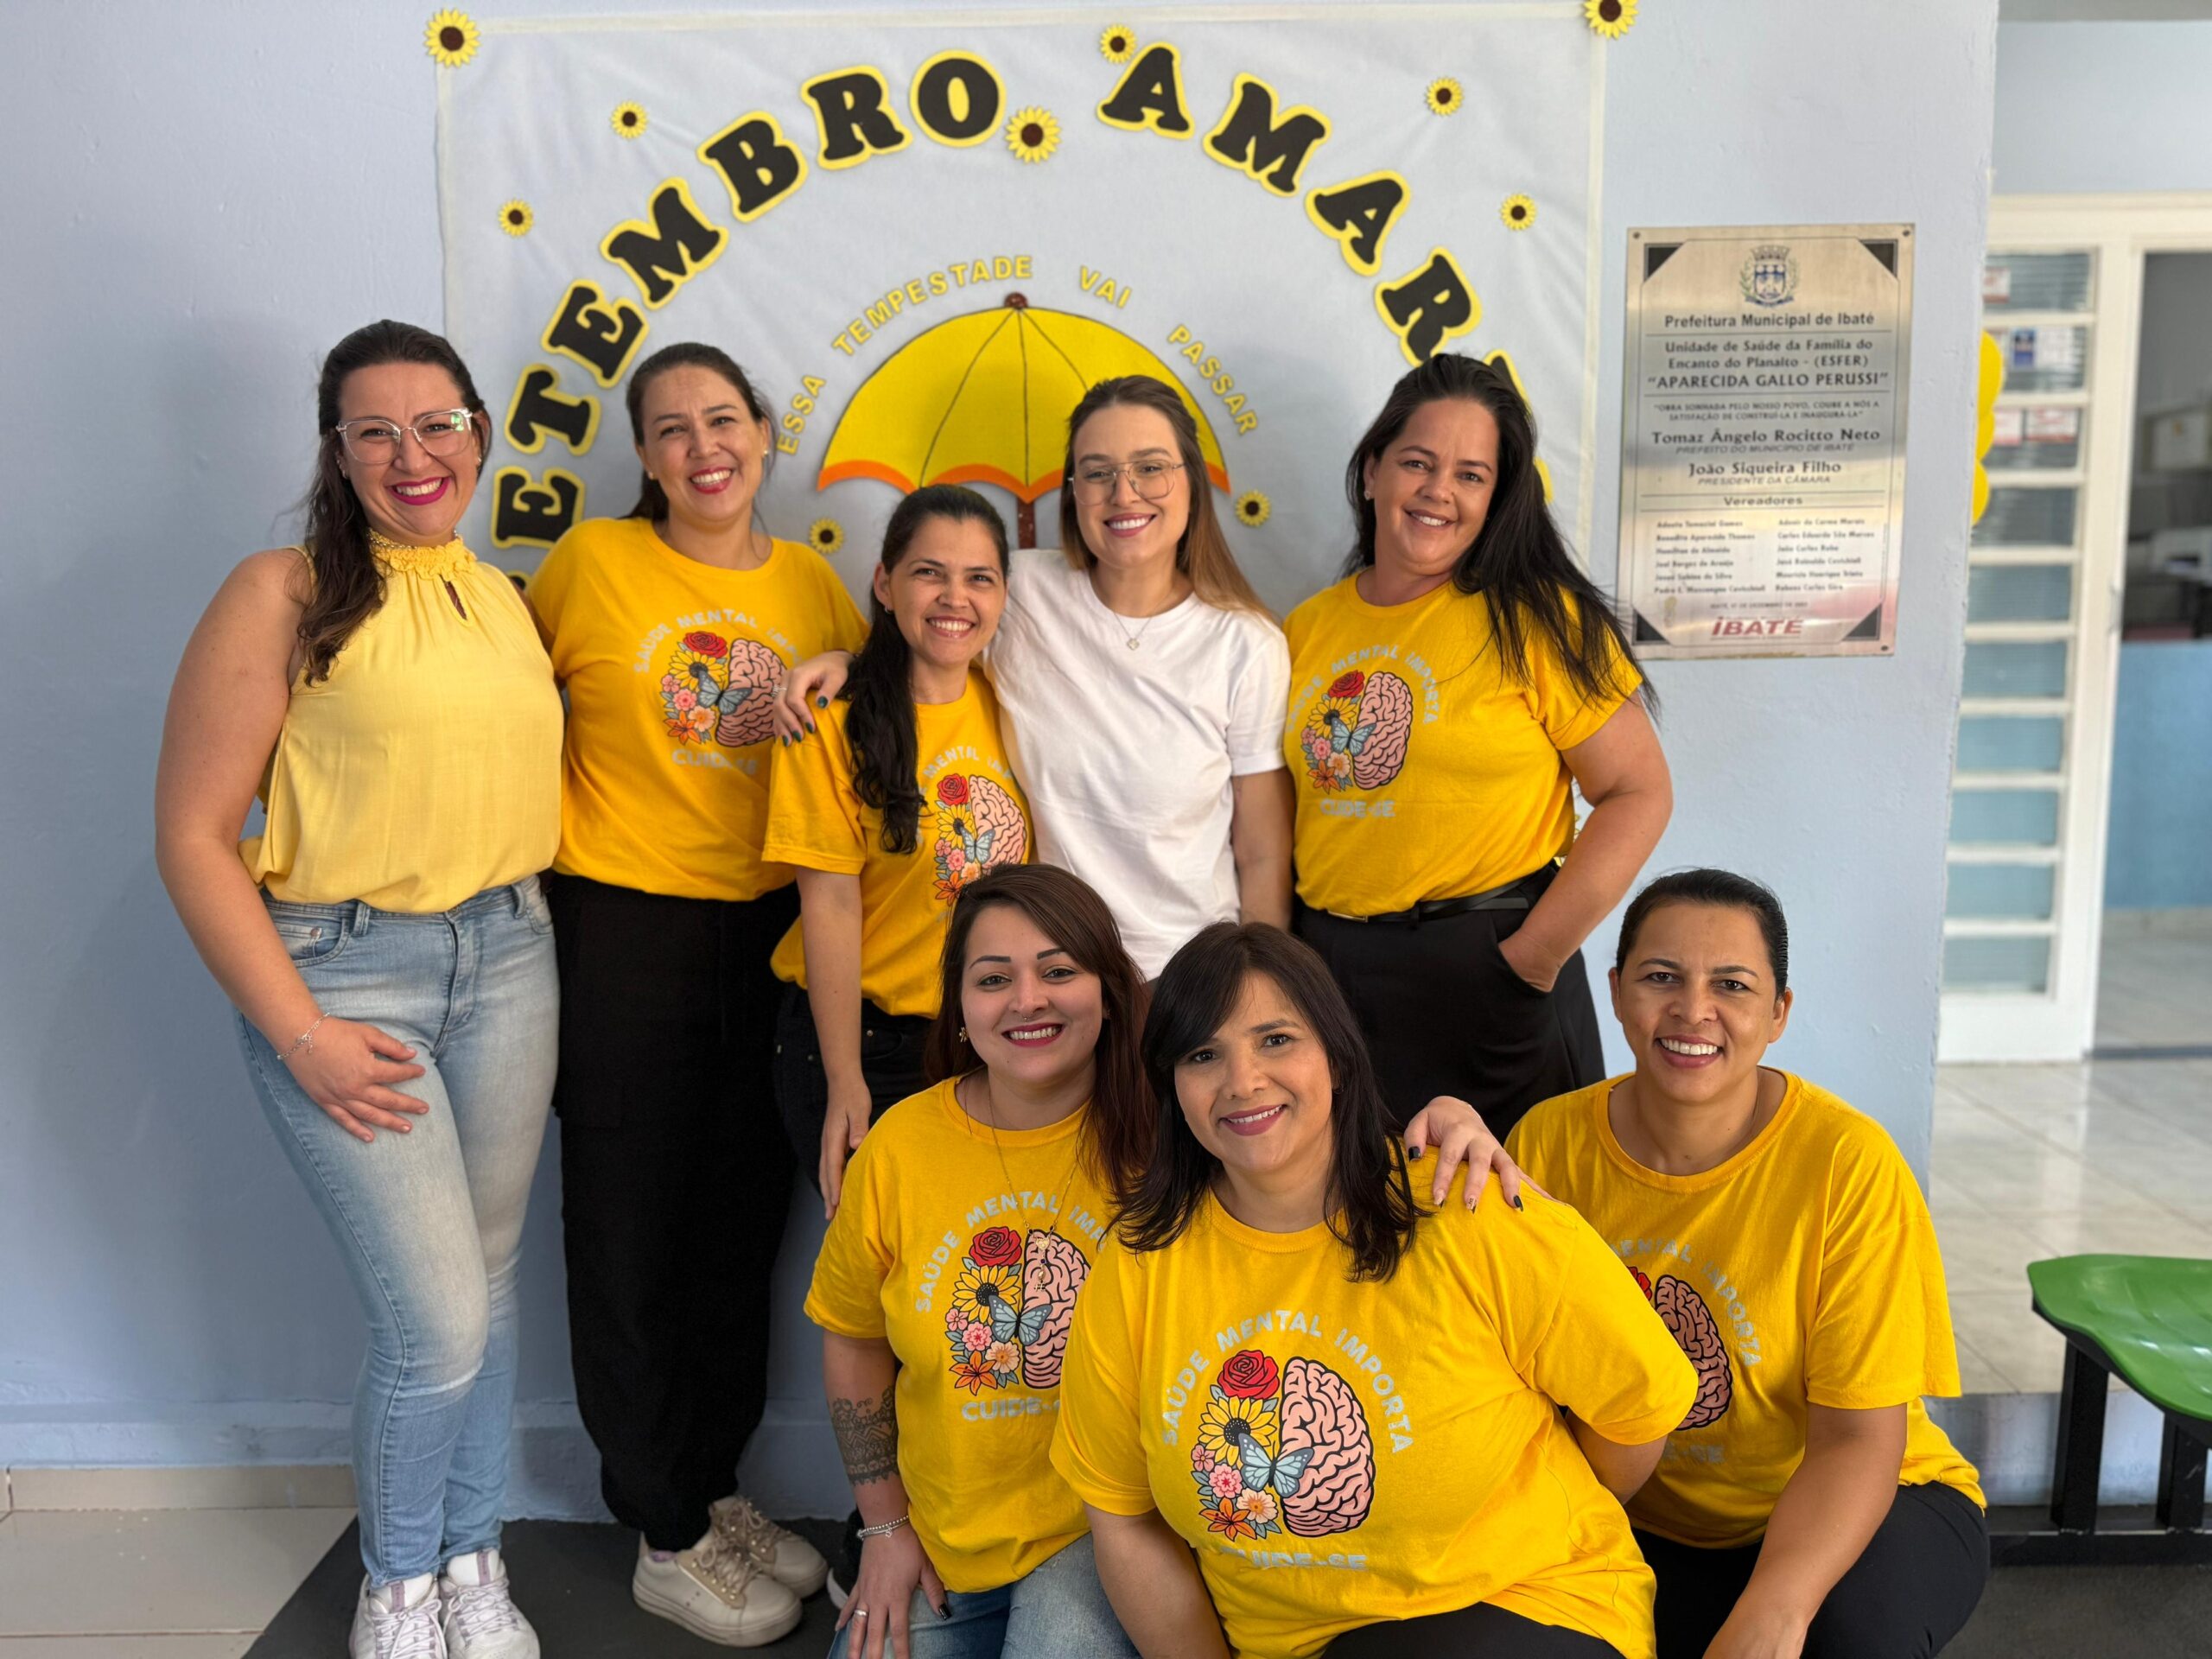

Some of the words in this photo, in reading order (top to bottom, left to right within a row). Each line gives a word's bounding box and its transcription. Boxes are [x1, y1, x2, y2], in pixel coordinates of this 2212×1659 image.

[490, 49, 1007, 591] ETEMBRO
[1096, 41, 1553, 504] AMAR
[1665, 315, 1737, 328] Prefeitura
[1742, 313, 1811, 328] Municipal
[1815, 313, 1833, 326] de
[1838, 311, 1875, 325] Ibaté
[1665, 342, 1719, 353] Unidade
[1723, 341, 1738, 352] de
[1744, 340, 1781, 352] Saúde
[1785, 340, 1801, 351] da
[1806, 338, 1852, 350] Família
[1856, 338, 1873, 349] do
[777, 374, 825, 455] ESSA
[832, 256, 1032, 358] TEMPESTADE
[1077, 265, 1133, 308] VAI
[1166, 324, 1257, 435] PASSAR
[1669, 358, 1719, 369] Encanto
[1725, 357, 1741, 368] do
[1746, 356, 1799, 368] Planalto
[1815, 354, 1869, 367] (ESFER)
[1756, 372, 1809, 387] GALLO
[1729, 402, 1750, 410] PELO
[1752, 401, 1781, 410] NOSSO
[1651, 430, 1705, 444] Tomaz
[1710, 428, 1768, 444] Ângelo
[1840, 429, 1880, 441] Neto
[1675, 445, 1728, 454] PREFEITO
[1730, 444, 1746, 454] DO
[1806, 443, 1821, 453] DE
[1688, 462, 1726, 477] João
[1732, 461, 1796, 476] Siqueira
[1802, 460, 1842, 474] Filho
[1697, 476, 1764, 486] PRESIDENTE
[1766, 476, 1783, 485] DA
[1723, 496, 1803, 506] Vereadores
[676, 607, 759, 629] MENTAL
[1331, 645, 1400, 674] MENTAL
[1404, 652, 1441, 725] IMPORTA
[965, 1190, 1060, 1228] MENTAL
[1701, 1259, 1762, 1368] IMPORTA
[1162, 1349, 1210, 1447] SAÚDE
[1216, 1309, 1323, 1353] MENTAL
[1333, 1327, 1415, 1454] IMPORTA
